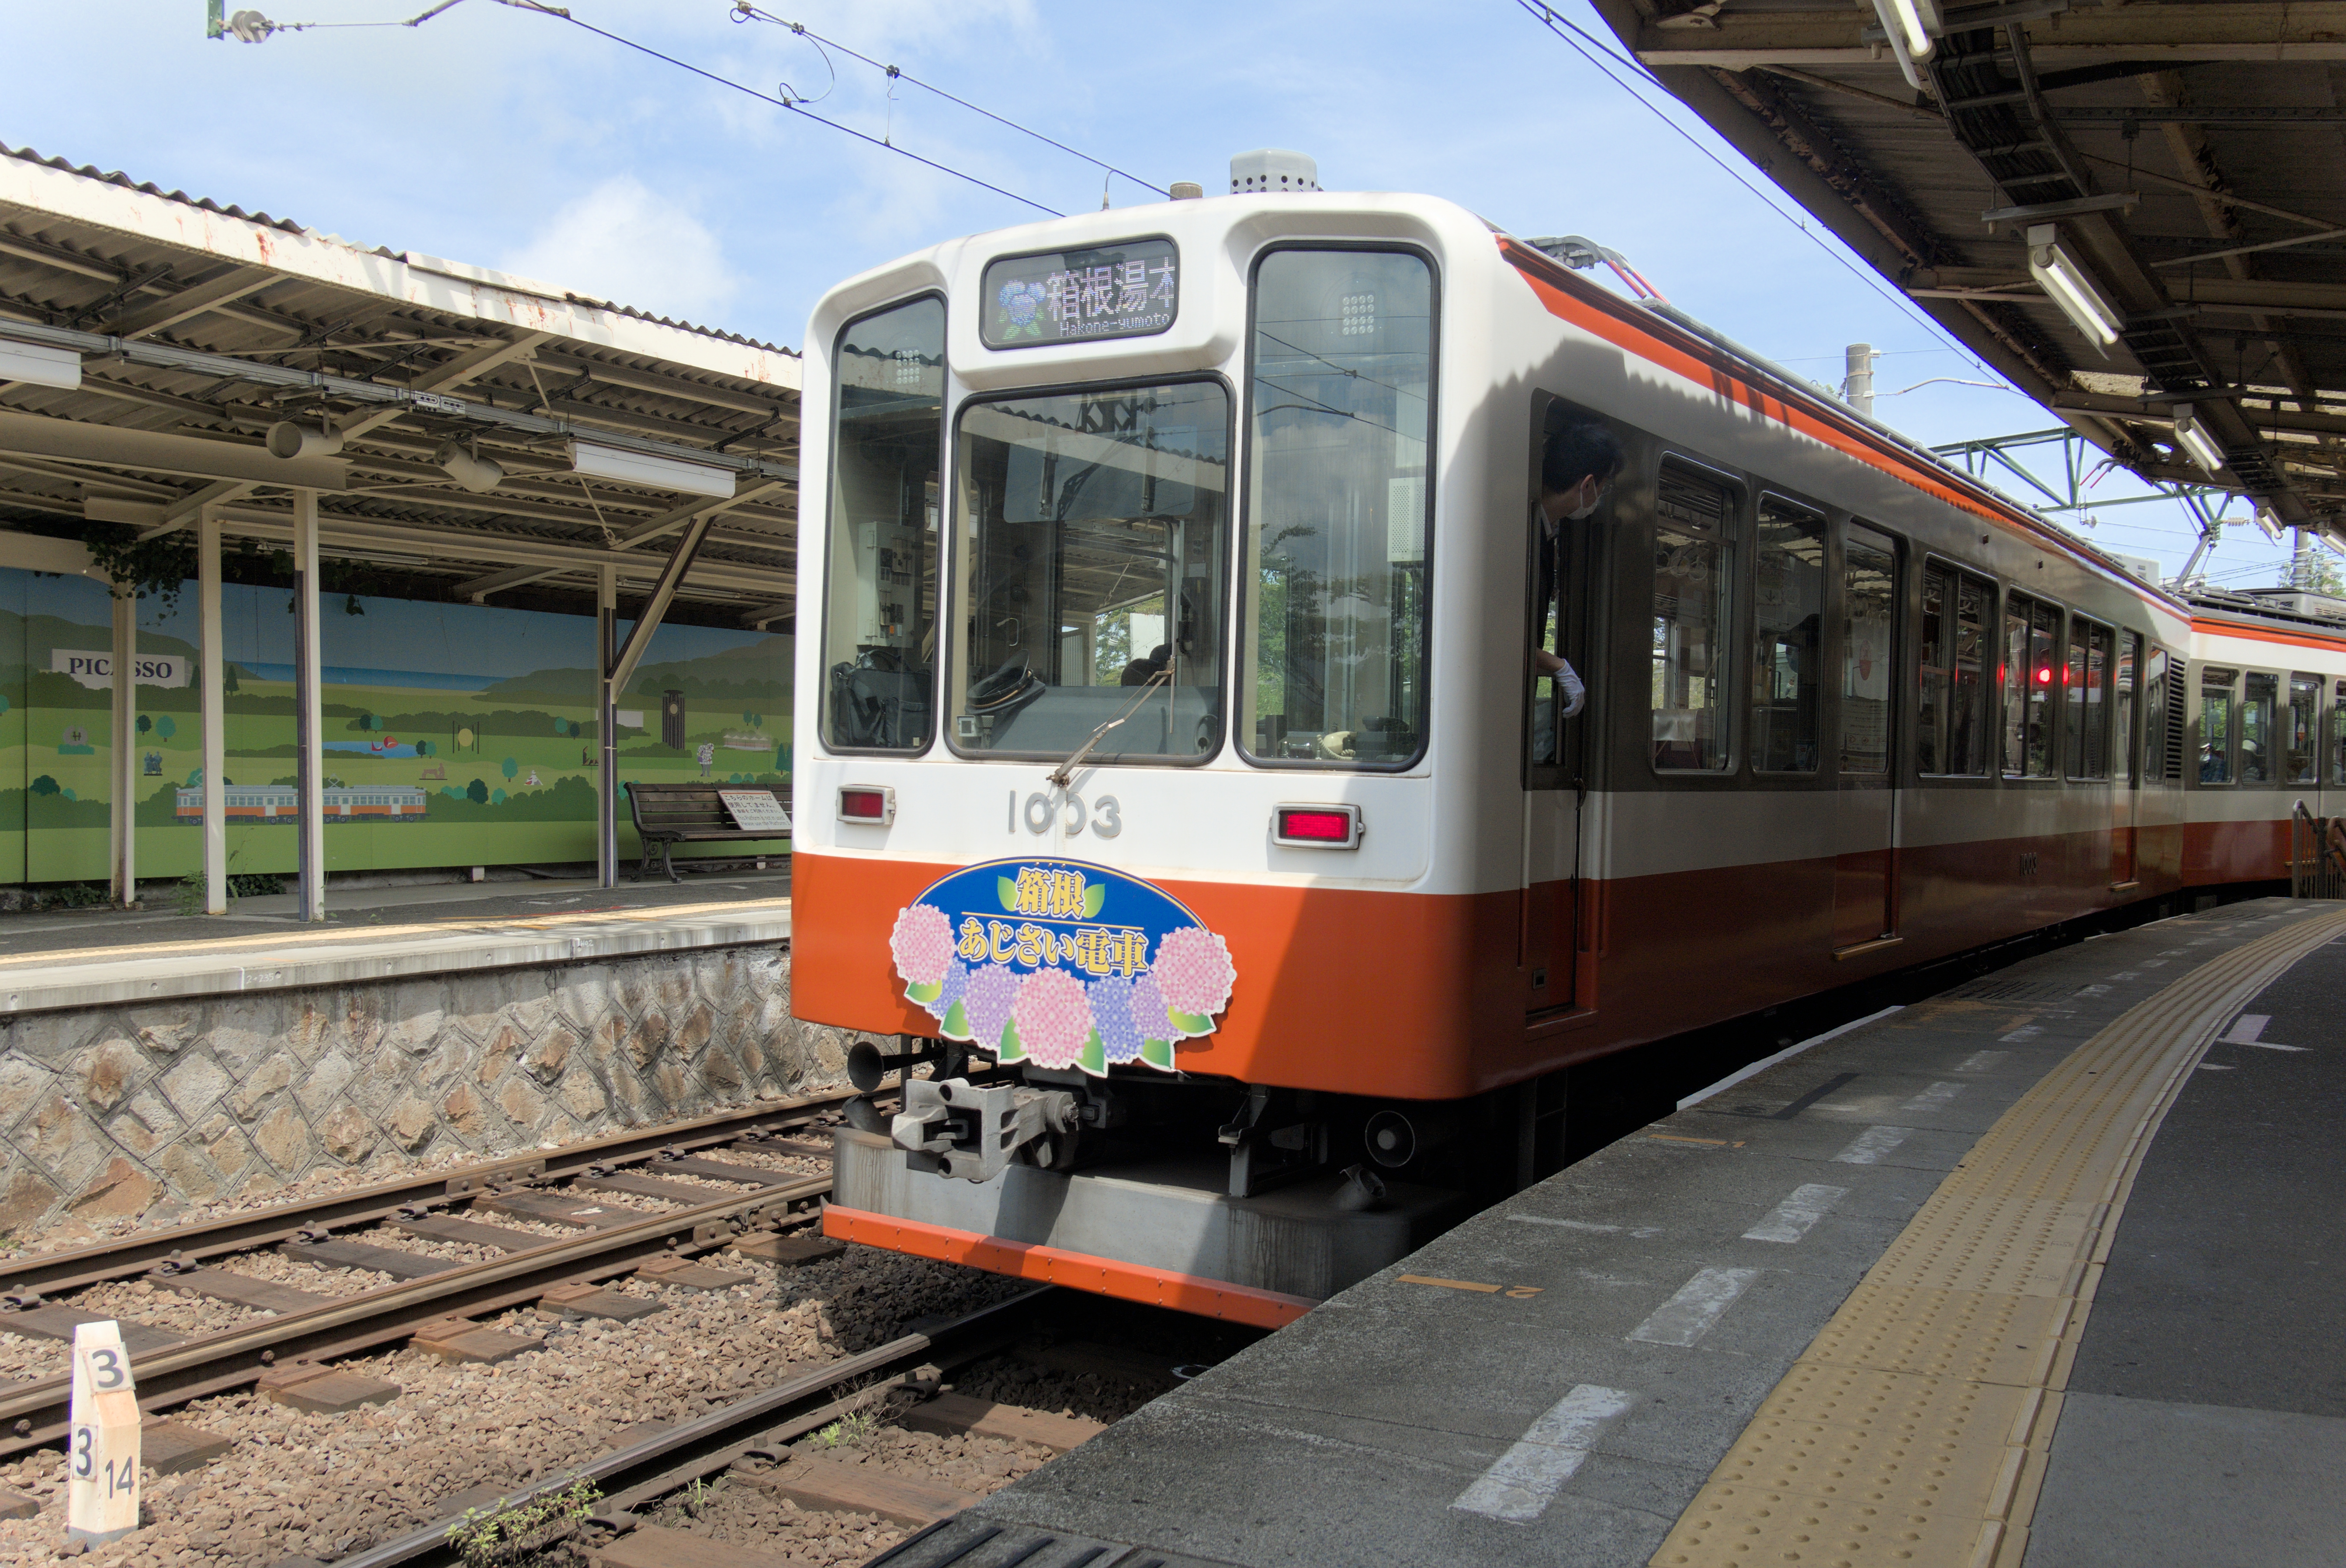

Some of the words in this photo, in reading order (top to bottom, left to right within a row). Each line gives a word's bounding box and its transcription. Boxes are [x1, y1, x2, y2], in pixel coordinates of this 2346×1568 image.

[1047, 257, 1175, 321] 箱根湯本
[69, 658, 173, 678] PICSO
[1008, 789, 1122, 838] 1003
[2019, 851, 2037, 876] 1003
[1015, 868, 1085, 919] 箱根
[959, 918, 1149, 978] あじさい電車
[92, 1349, 125, 1388] 3
[76, 1428, 92, 1476] 3
[105, 1456, 135, 1499] 14
